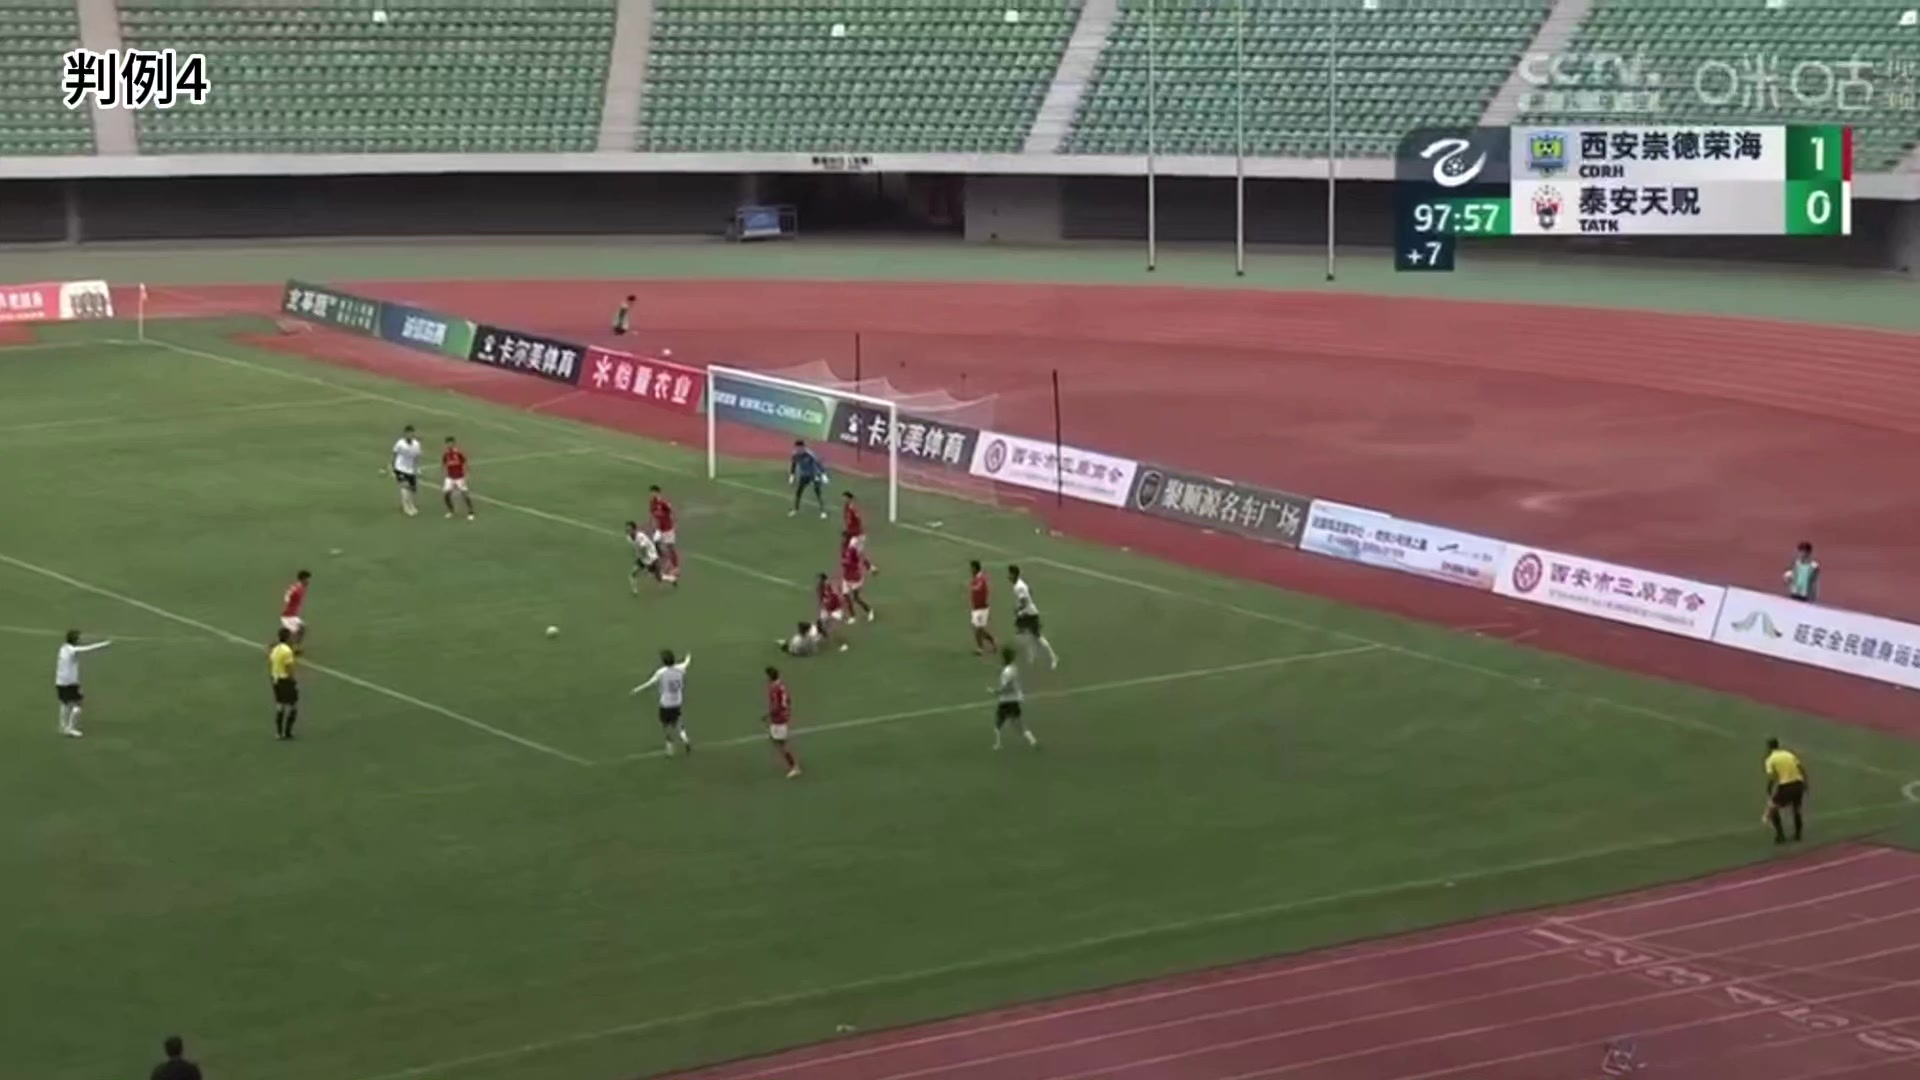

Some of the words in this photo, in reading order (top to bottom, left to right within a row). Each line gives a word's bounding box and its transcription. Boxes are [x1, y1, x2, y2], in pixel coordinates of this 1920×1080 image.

[499, 336, 577, 378] 卡尔美体育
[1550, 562, 1705, 613] 西安市三原商会
